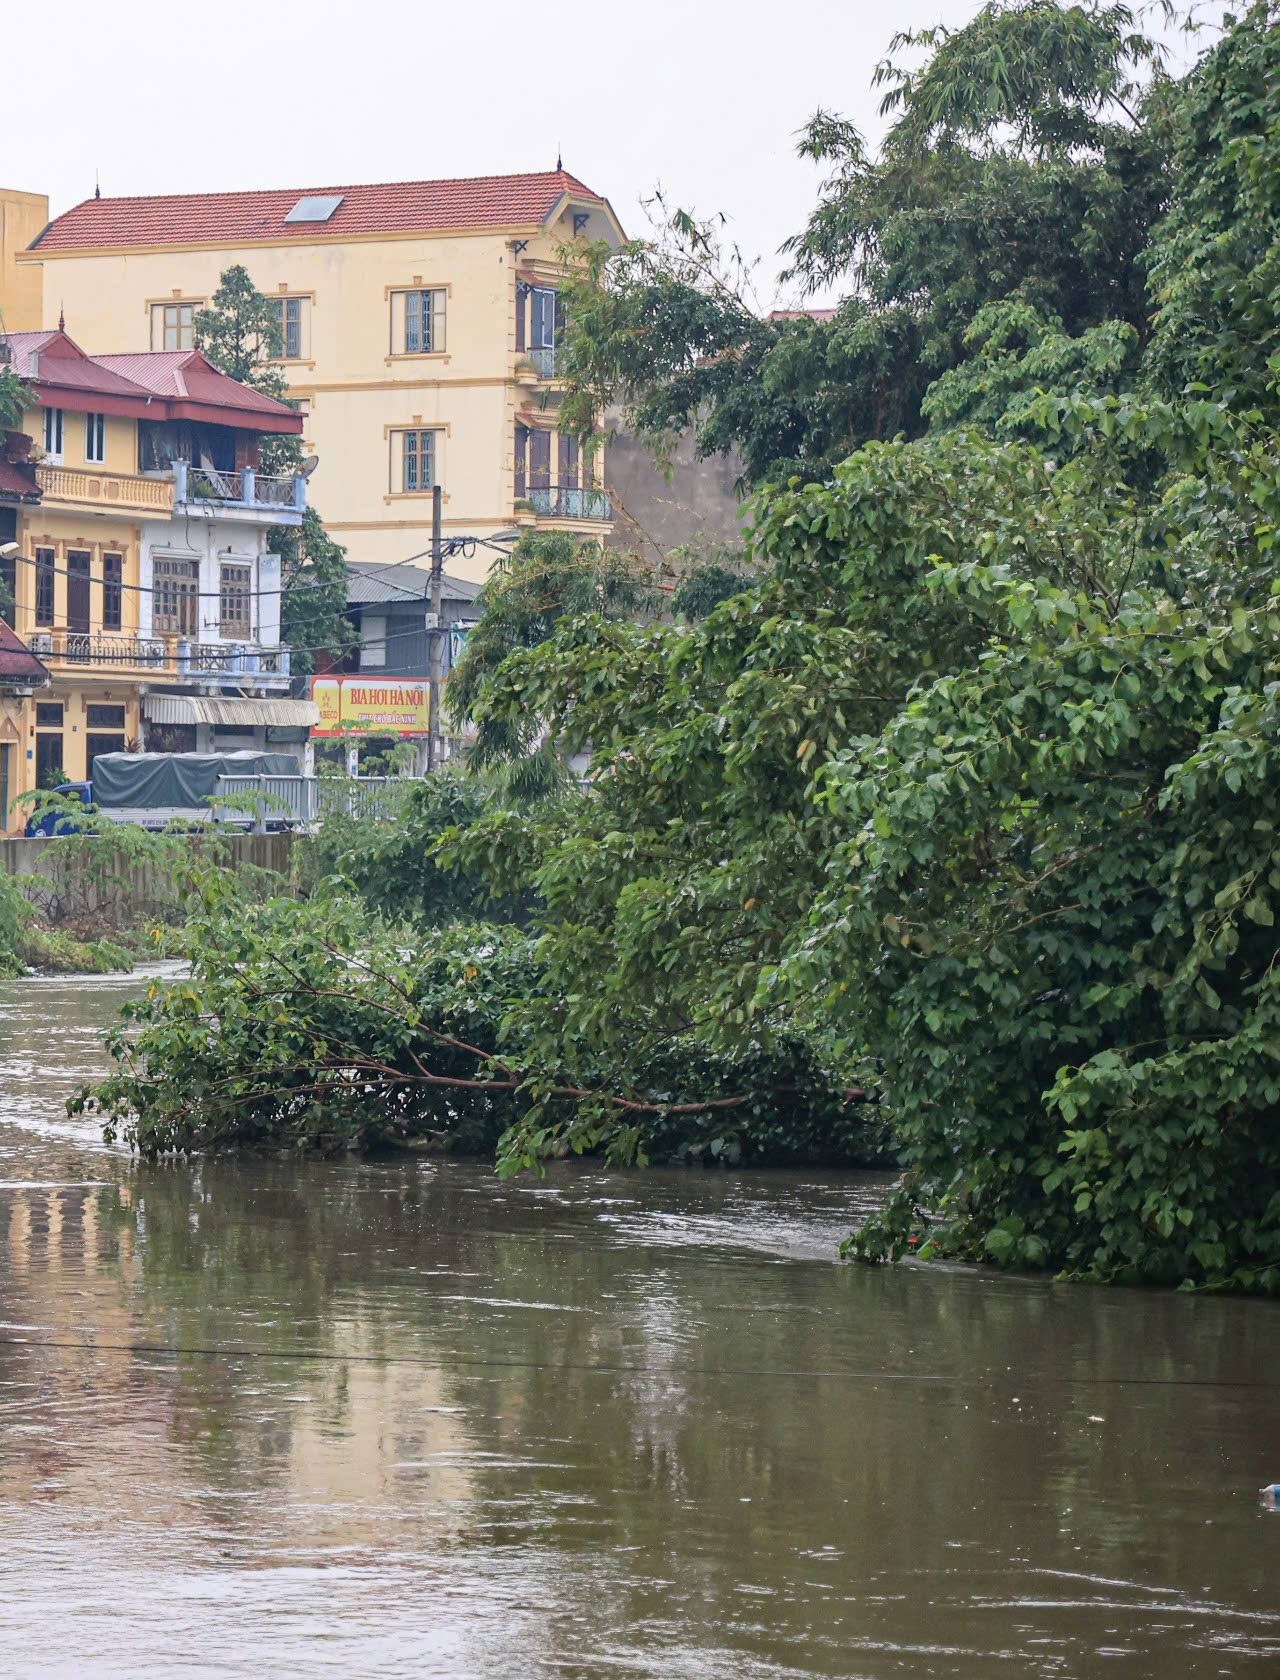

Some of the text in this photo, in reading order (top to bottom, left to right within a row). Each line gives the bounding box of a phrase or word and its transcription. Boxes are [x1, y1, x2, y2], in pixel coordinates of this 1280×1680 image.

[350, 688, 367, 705] BIA
[369, 688, 387, 706] HƠI
[390, 685, 404, 706] HÀ
